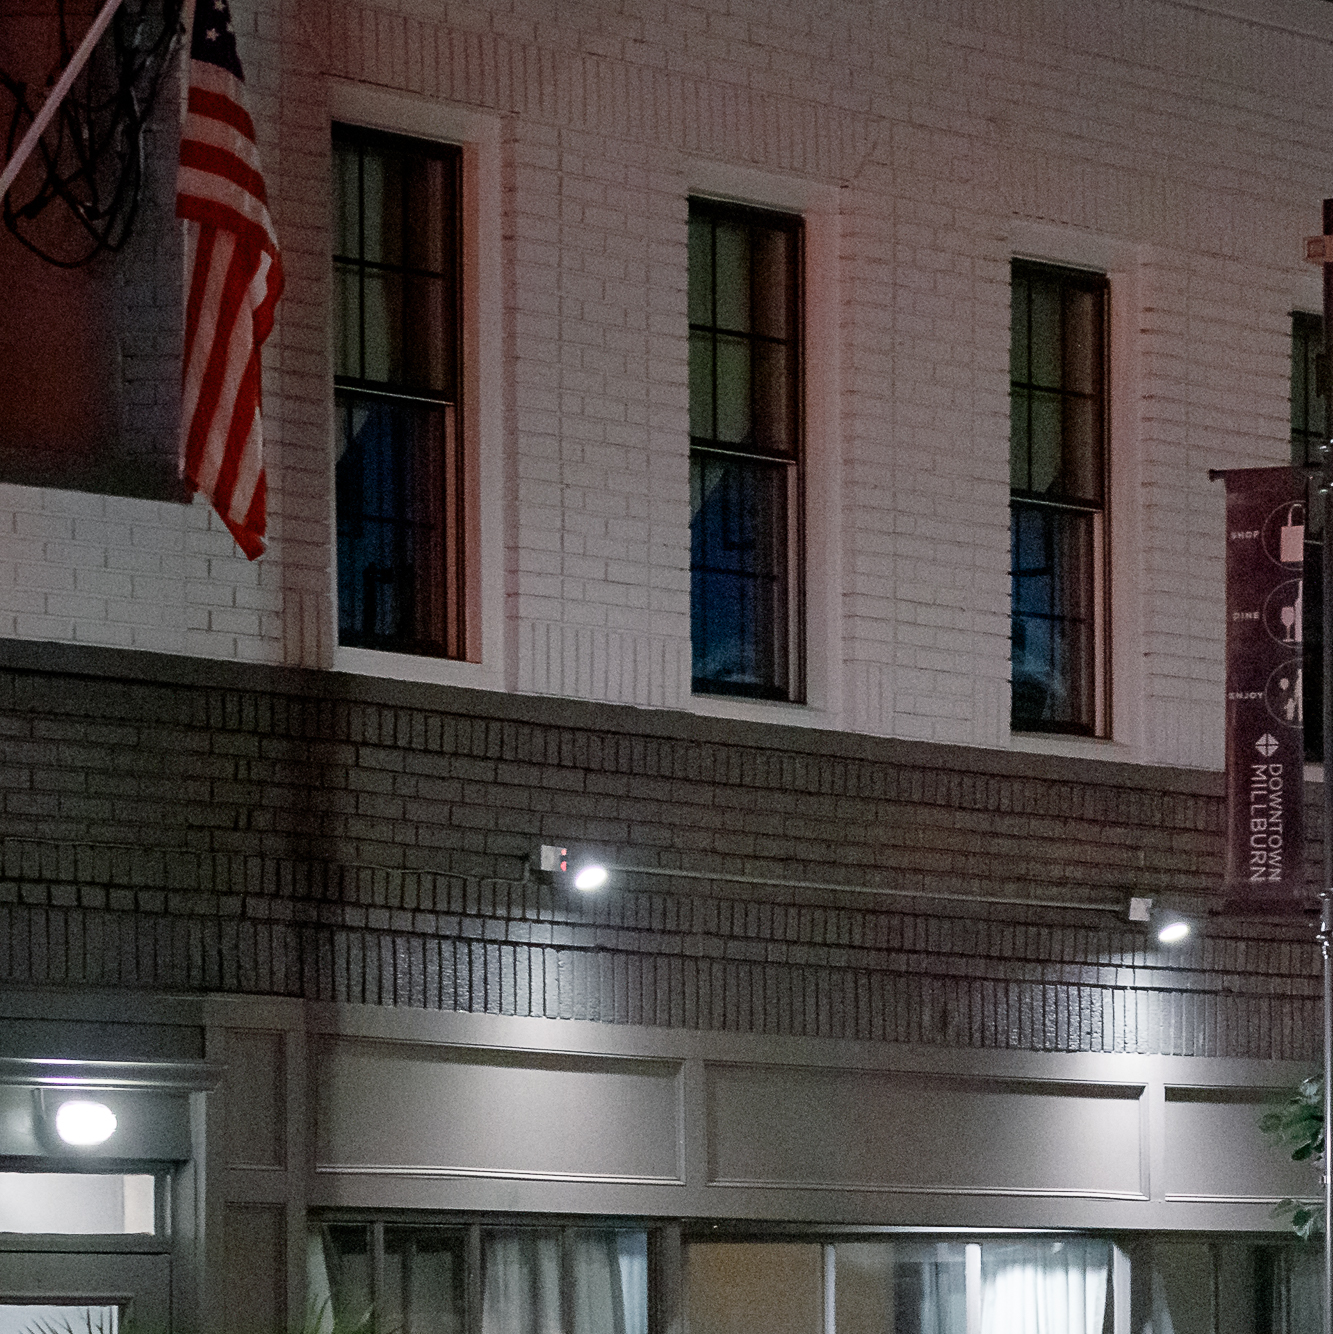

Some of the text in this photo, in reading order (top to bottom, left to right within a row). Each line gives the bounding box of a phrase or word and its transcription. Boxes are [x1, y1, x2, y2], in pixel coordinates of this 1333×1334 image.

[1231, 530, 1260, 540] SHOP
[1232, 611, 1261, 621] DINE
[1249, 763, 1268, 883] MILLBURN
[1268, 763, 1284, 882] DOWNTOWN
